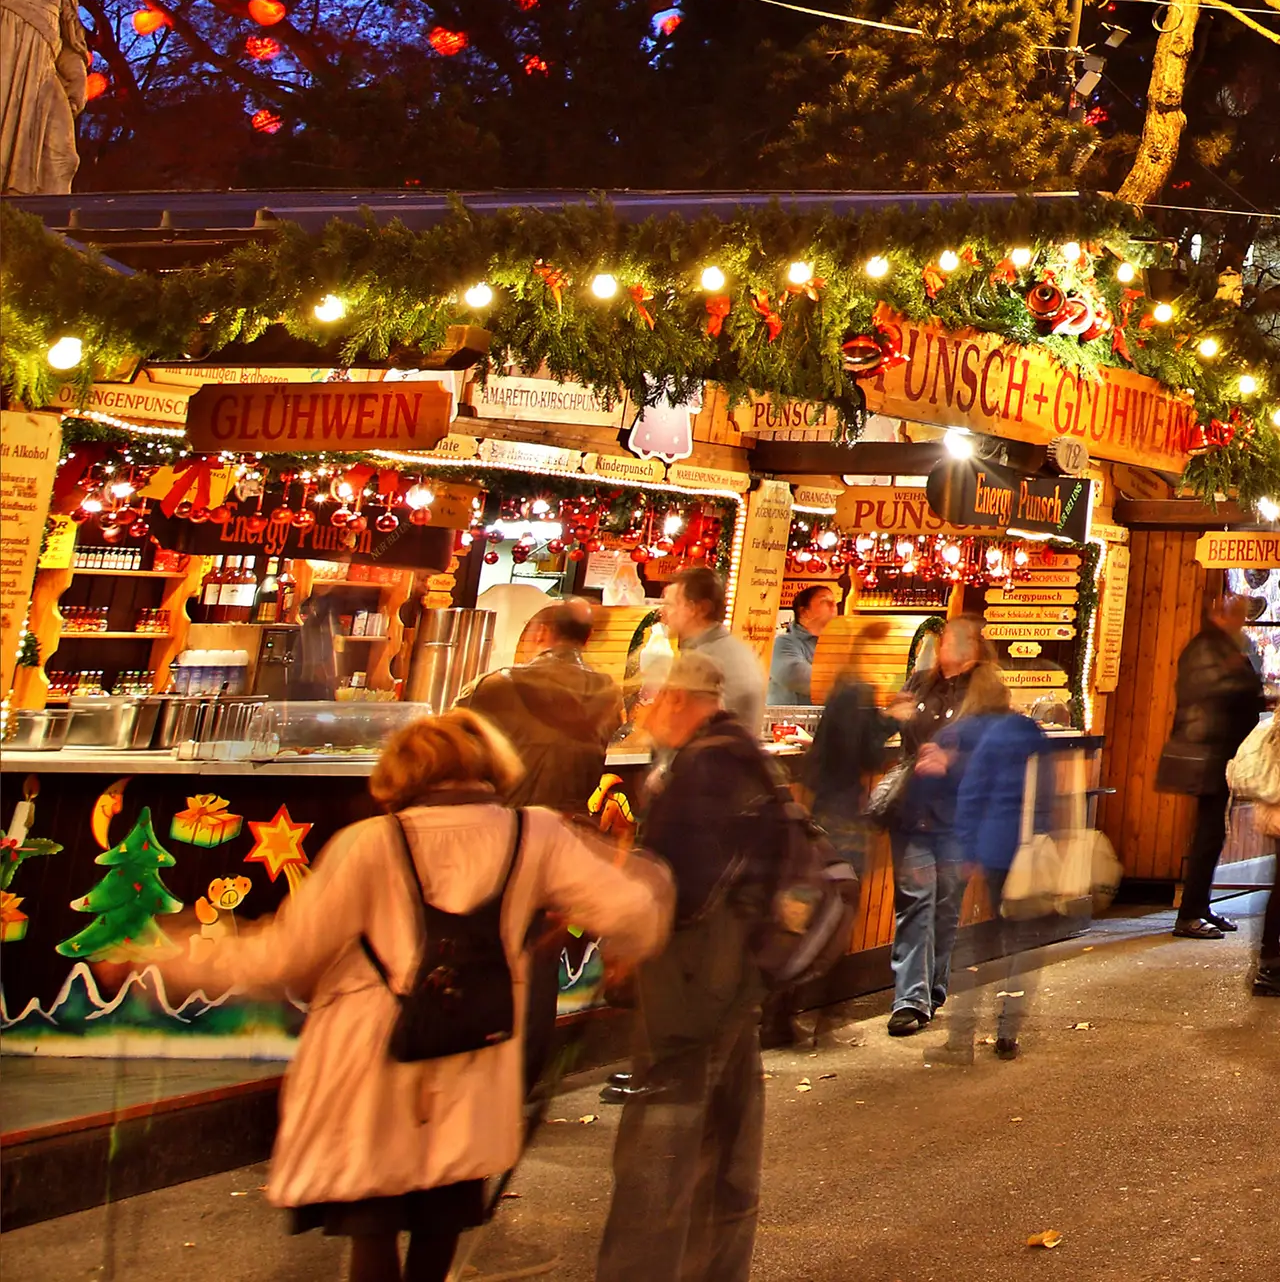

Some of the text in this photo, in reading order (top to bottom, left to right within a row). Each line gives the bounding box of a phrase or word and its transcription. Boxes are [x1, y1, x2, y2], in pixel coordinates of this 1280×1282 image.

[481, 386, 614, 412] AMARETTO-KIRSCHPUNS
[1054, 365, 1193, 457] GLÜHWEIN
[210, 385, 422, 440] GLÜHWEIN
[12, 445, 49, 460] Alkohol
[596, 456, 653, 477] Kinderpunsch
[975, 473, 1014, 526] Energy
[1017, 480, 1061, 524] Punsch
[852, 500, 998, 530] PUNS
[1003, 591, 1062, 602] Energypunsch
[990, 626, 1051, 636] GLÜHWEIN ROT
